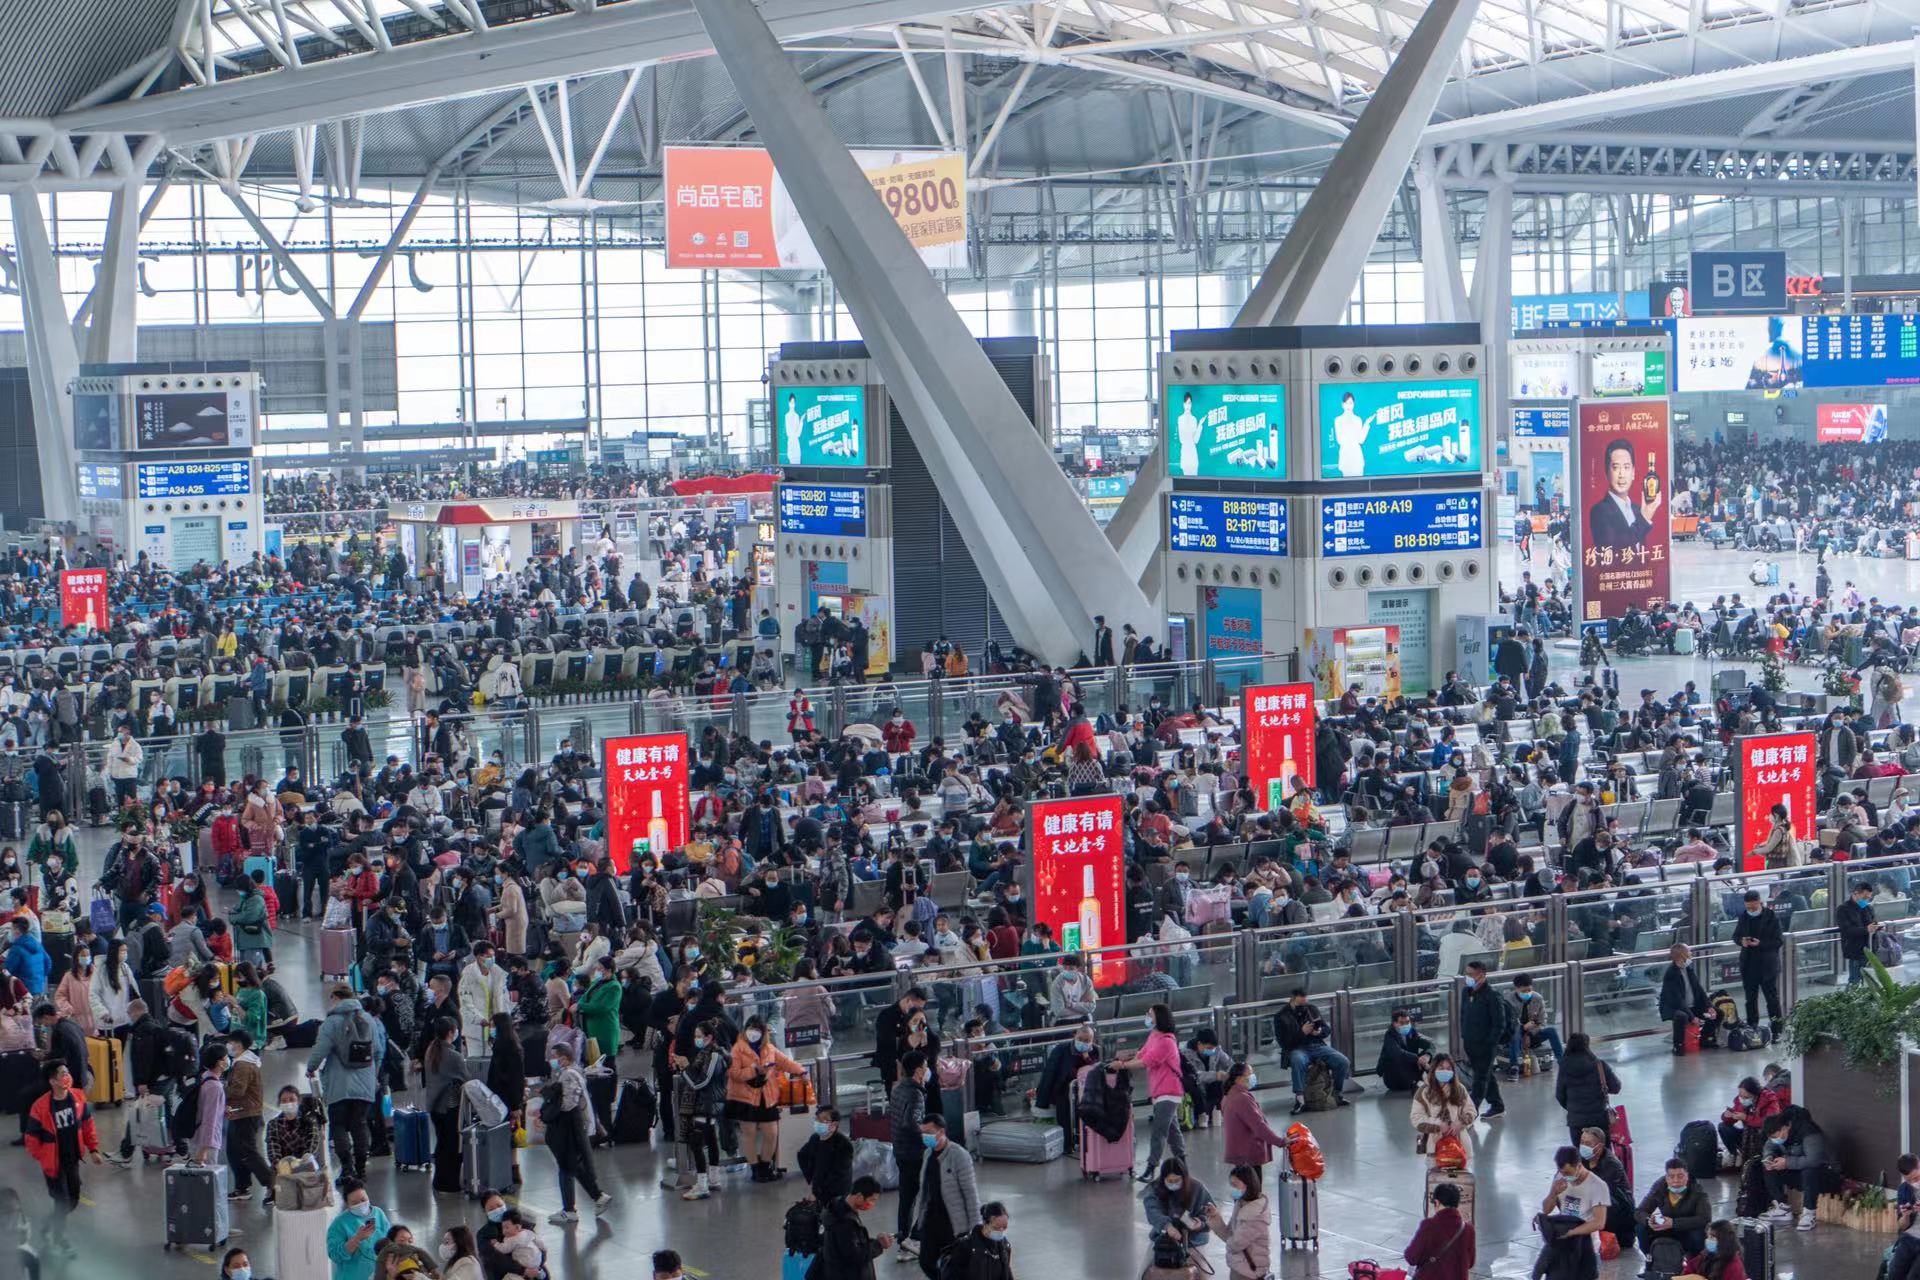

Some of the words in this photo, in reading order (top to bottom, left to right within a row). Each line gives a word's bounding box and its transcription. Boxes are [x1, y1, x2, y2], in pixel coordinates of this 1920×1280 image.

[676, 184, 763, 209] 尚品宅配
[1711, 263, 1767, 297] B区
[1785, 275, 1823, 296] KFC
[1376, 402, 1404, 425] 新风
[168, 466, 184, 475] A28
[1200, 534, 1217, 547] A28
[1253, 693, 1307, 713] 健康有请
[615, 743, 680, 767] 健康有请
[1750, 744, 1808, 768] 健康有请
[623, 765, 673, 782] 天地壹号
[1043, 809, 1114, 837] 健康有请
[1051, 834, 1107, 856] 天地壹号
